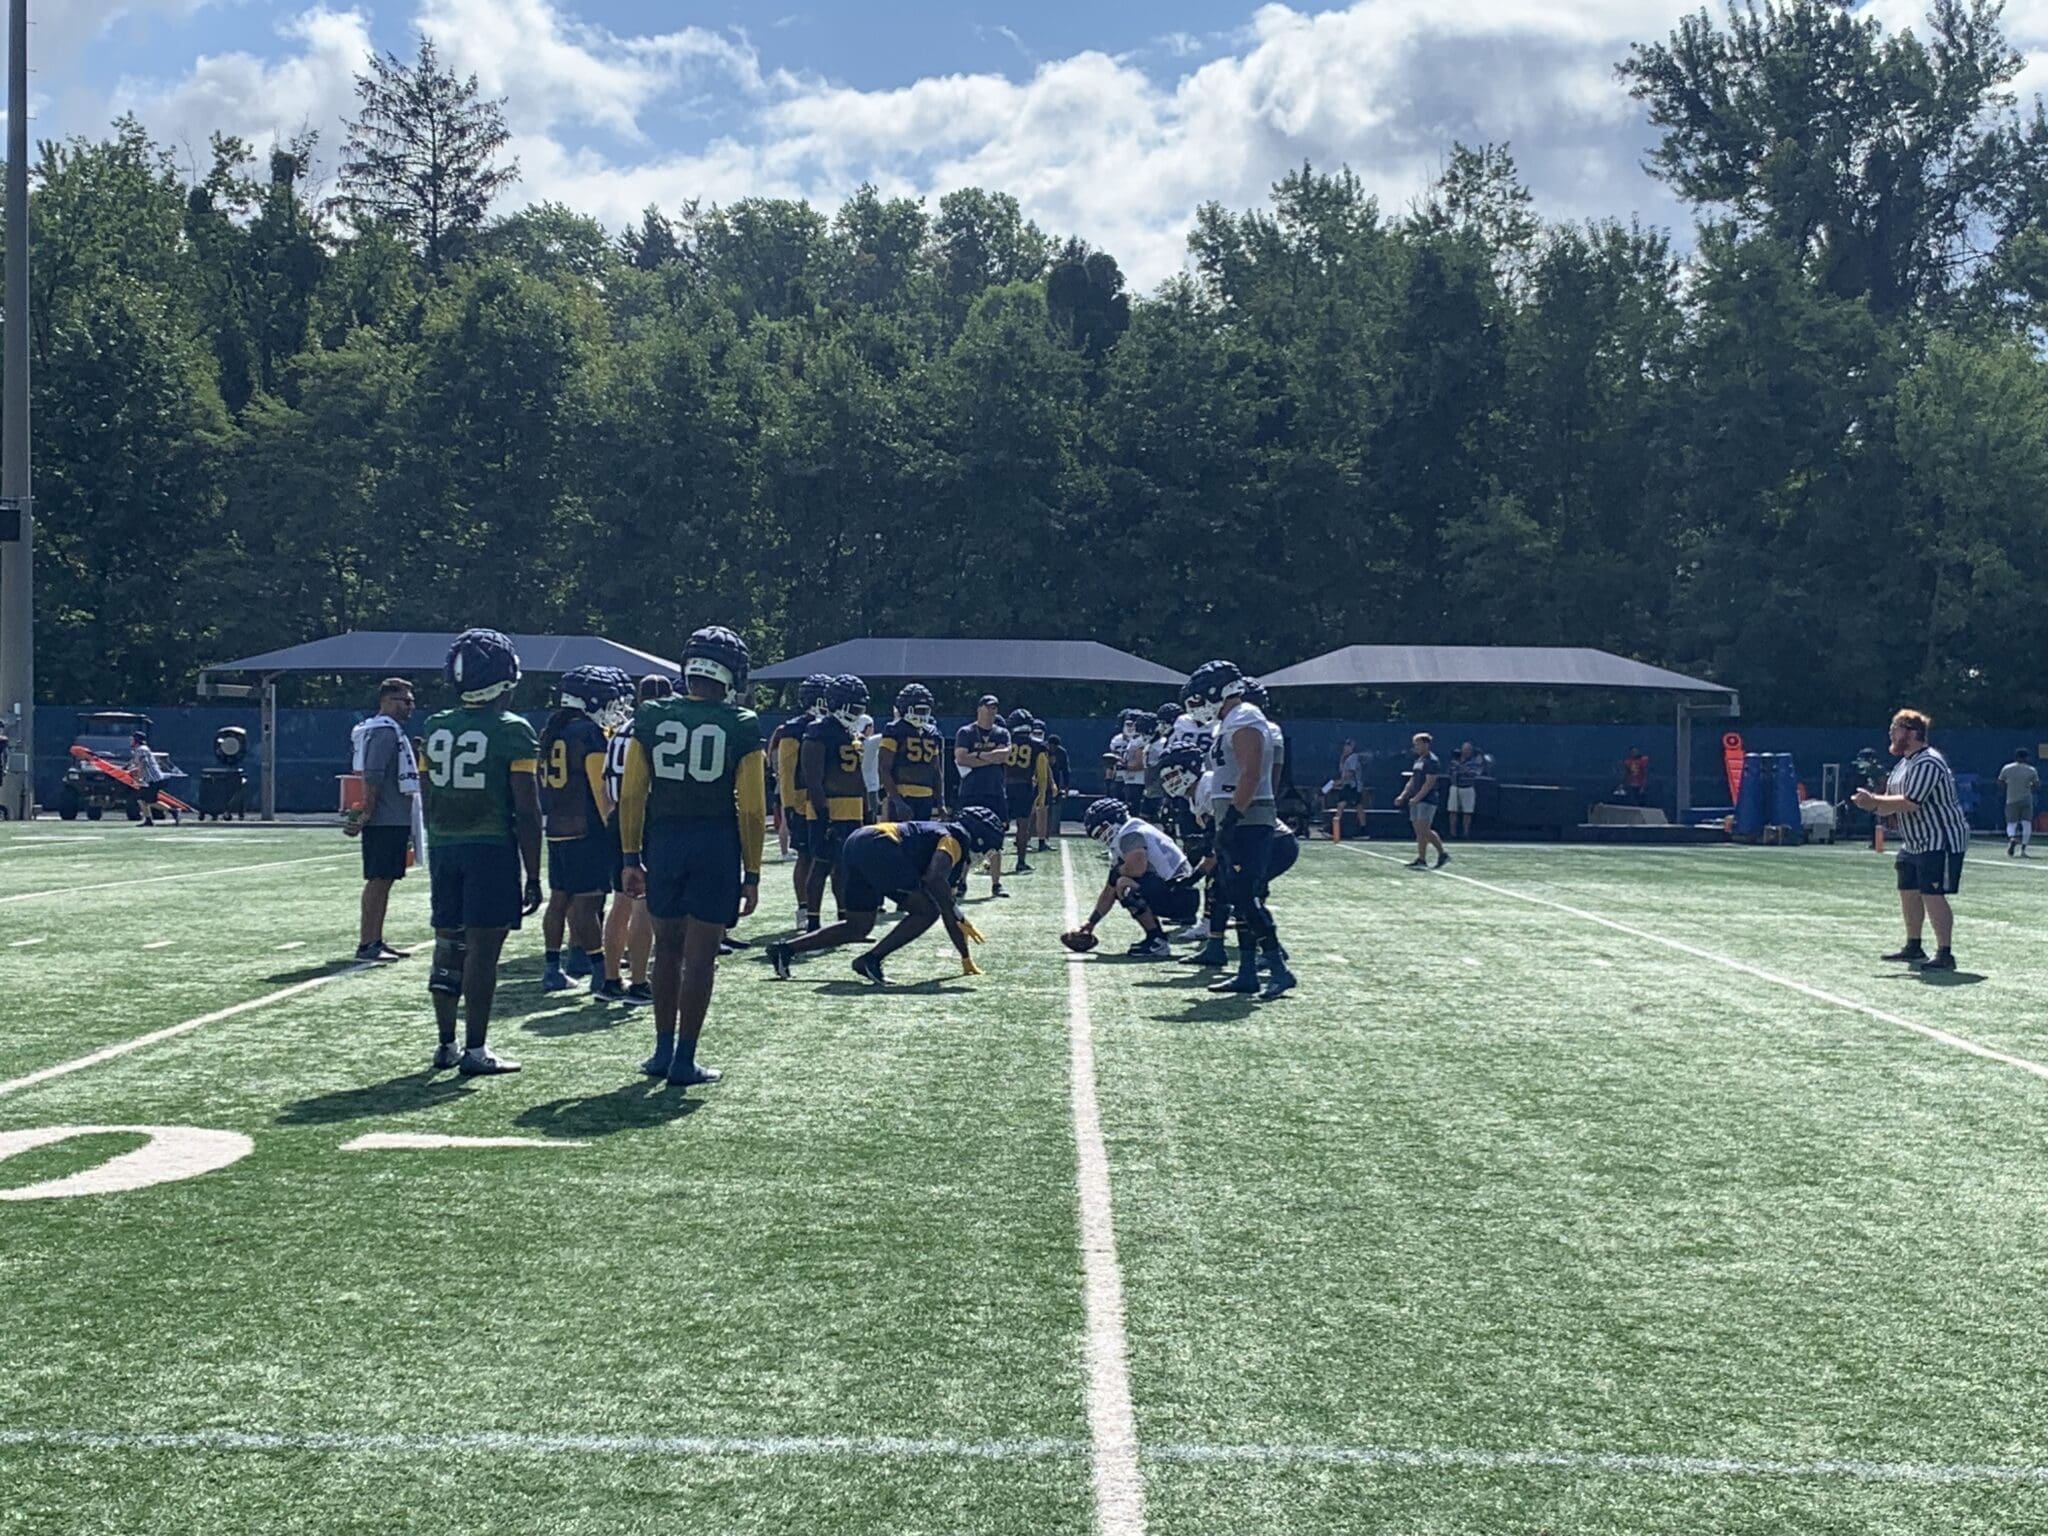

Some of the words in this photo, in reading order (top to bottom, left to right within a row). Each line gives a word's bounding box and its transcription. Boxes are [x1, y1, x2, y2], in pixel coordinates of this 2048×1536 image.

[427, 728, 488, 789] 92
[652, 720, 726, 782] 20
[906, 737, 937, 762] 55
